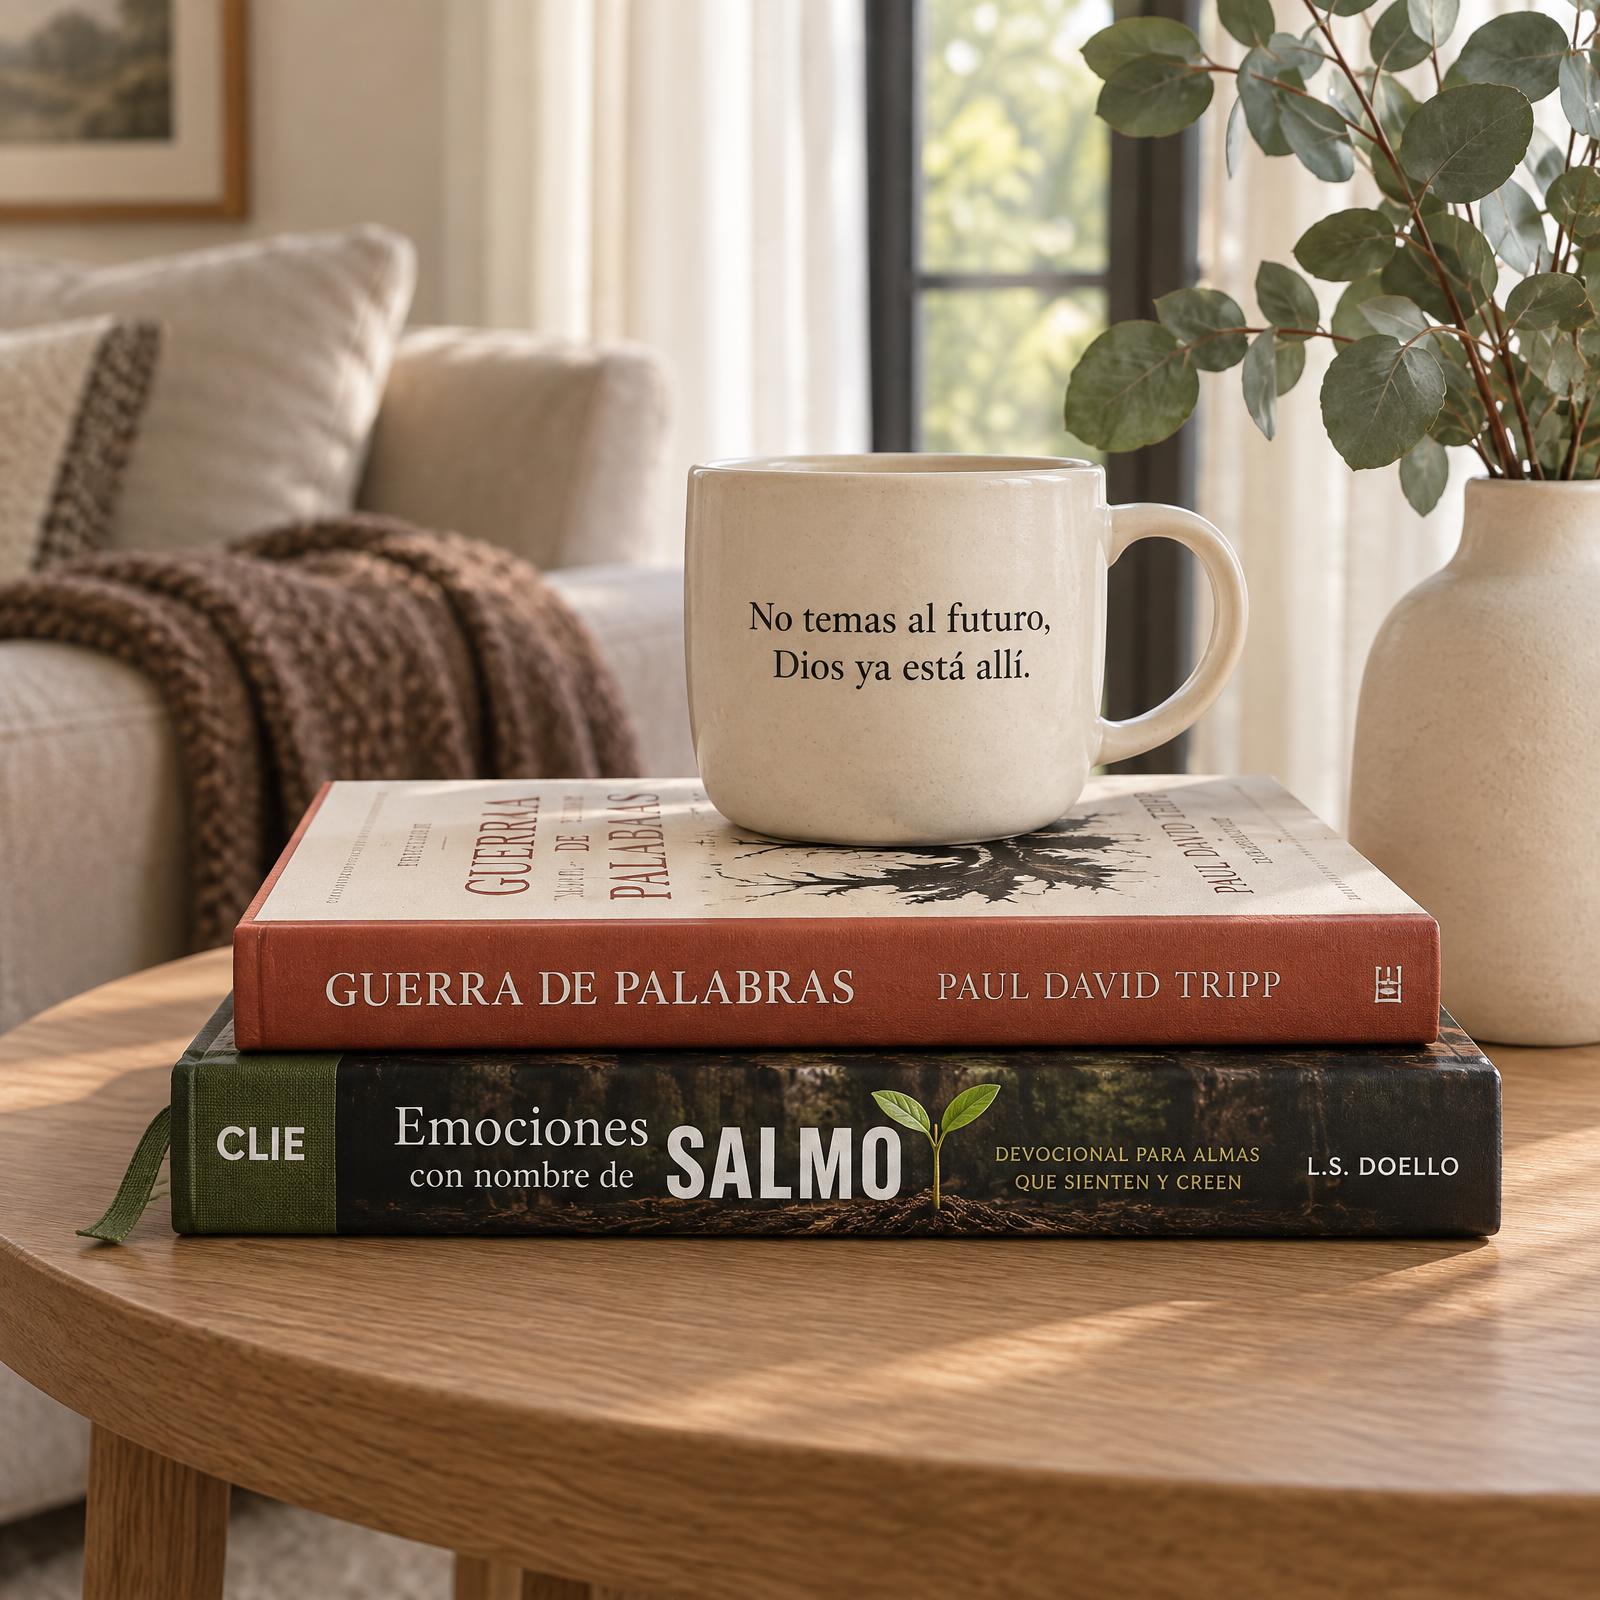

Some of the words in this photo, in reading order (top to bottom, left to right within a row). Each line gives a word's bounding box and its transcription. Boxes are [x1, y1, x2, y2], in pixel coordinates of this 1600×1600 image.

[750, 602, 792, 631] No
[803, 609, 896, 633] temas
[909, 603, 935, 633] al
[948, 602, 1049, 634] futuro,
[774, 650, 843, 680] Dios
[855, 661, 891, 689] ya
[903, 652, 965, 680] está
[977, 649, 1029, 679] allí.
[555, 834, 589, 853] DE
[1161, 823, 1220, 857] DAVID
[1194, 862, 1254, 894] PAUL
[326, 972, 523, 1006] GUERRA
[539, 972, 596, 1004] DE
[615, 970, 853, 1004] PALABRAS
[938, 973, 1028, 999] PAUL
[1045, 972, 1159, 998] DAVID
[1175, 972, 1280, 997] TRIPP
[395, 1107, 647, 1146] Emociones
[217, 1126, 304, 1160] CLIE
[996, 1147, 1128, 1161] DEVOCIONAL
[1137, 1147, 1185, 1161] PARA
[1193, 1148, 1259, 1161] ALMAS
[411, 1170, 463, 1187] con
[475, 1161, 589, 1187] nombre
[600, 1161, 633, 1187] de
[667, 1126, 901, 1200] SALMO
[1309, 1157, 1348, 1175] L.S.
[1360, 1157, 1458, 1175] DOELLO
[1016, 1175, 1056, 1191] QUE
[1065, 1175, 1148, 1189] SIENTEN
[1157, 1175, 1168, 1189] Y
[1177, 1175, 1240, 1189] CREEN
